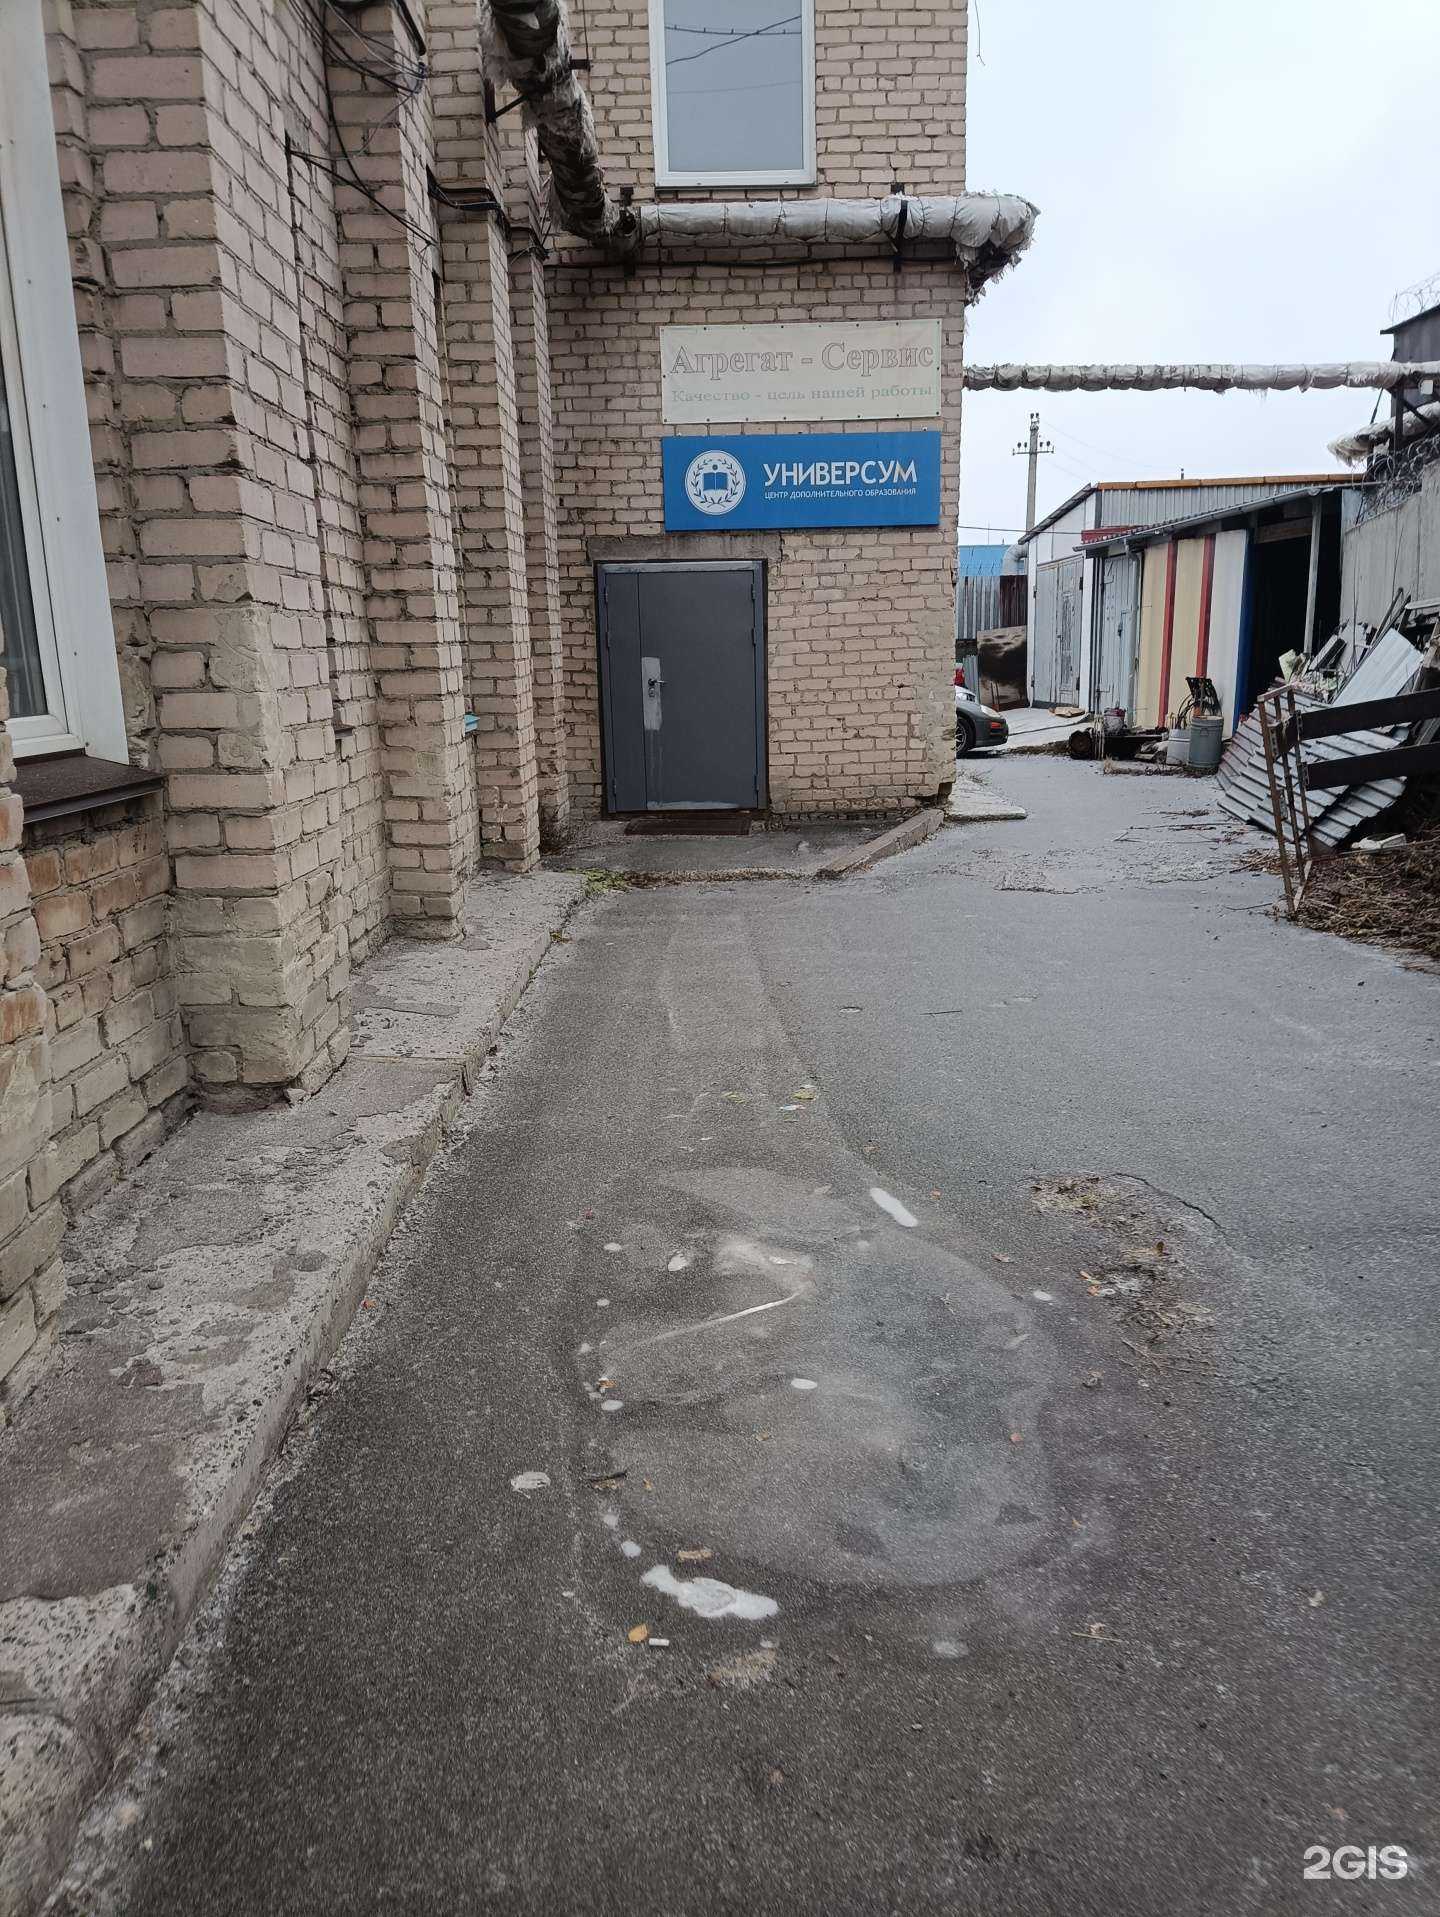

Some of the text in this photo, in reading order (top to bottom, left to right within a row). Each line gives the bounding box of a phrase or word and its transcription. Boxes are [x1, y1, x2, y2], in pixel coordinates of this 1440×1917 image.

[670, 345, 793, 380] Агрегат
[821, 341, 934, 377] Сервис
[672, 389, 750, 403] Качество
[767, 389, 804, 402] цель
[811, 386, 865, 399] нашей
[871, 384, 932, 399] работы
[763, 459, 918, 487] УНИВЕРСУМ
[764, 487, 917, 501] ЦЕНТР ДОПОЛНИТЕЛЬНОГО ОБРАЗОВАНИЯ
